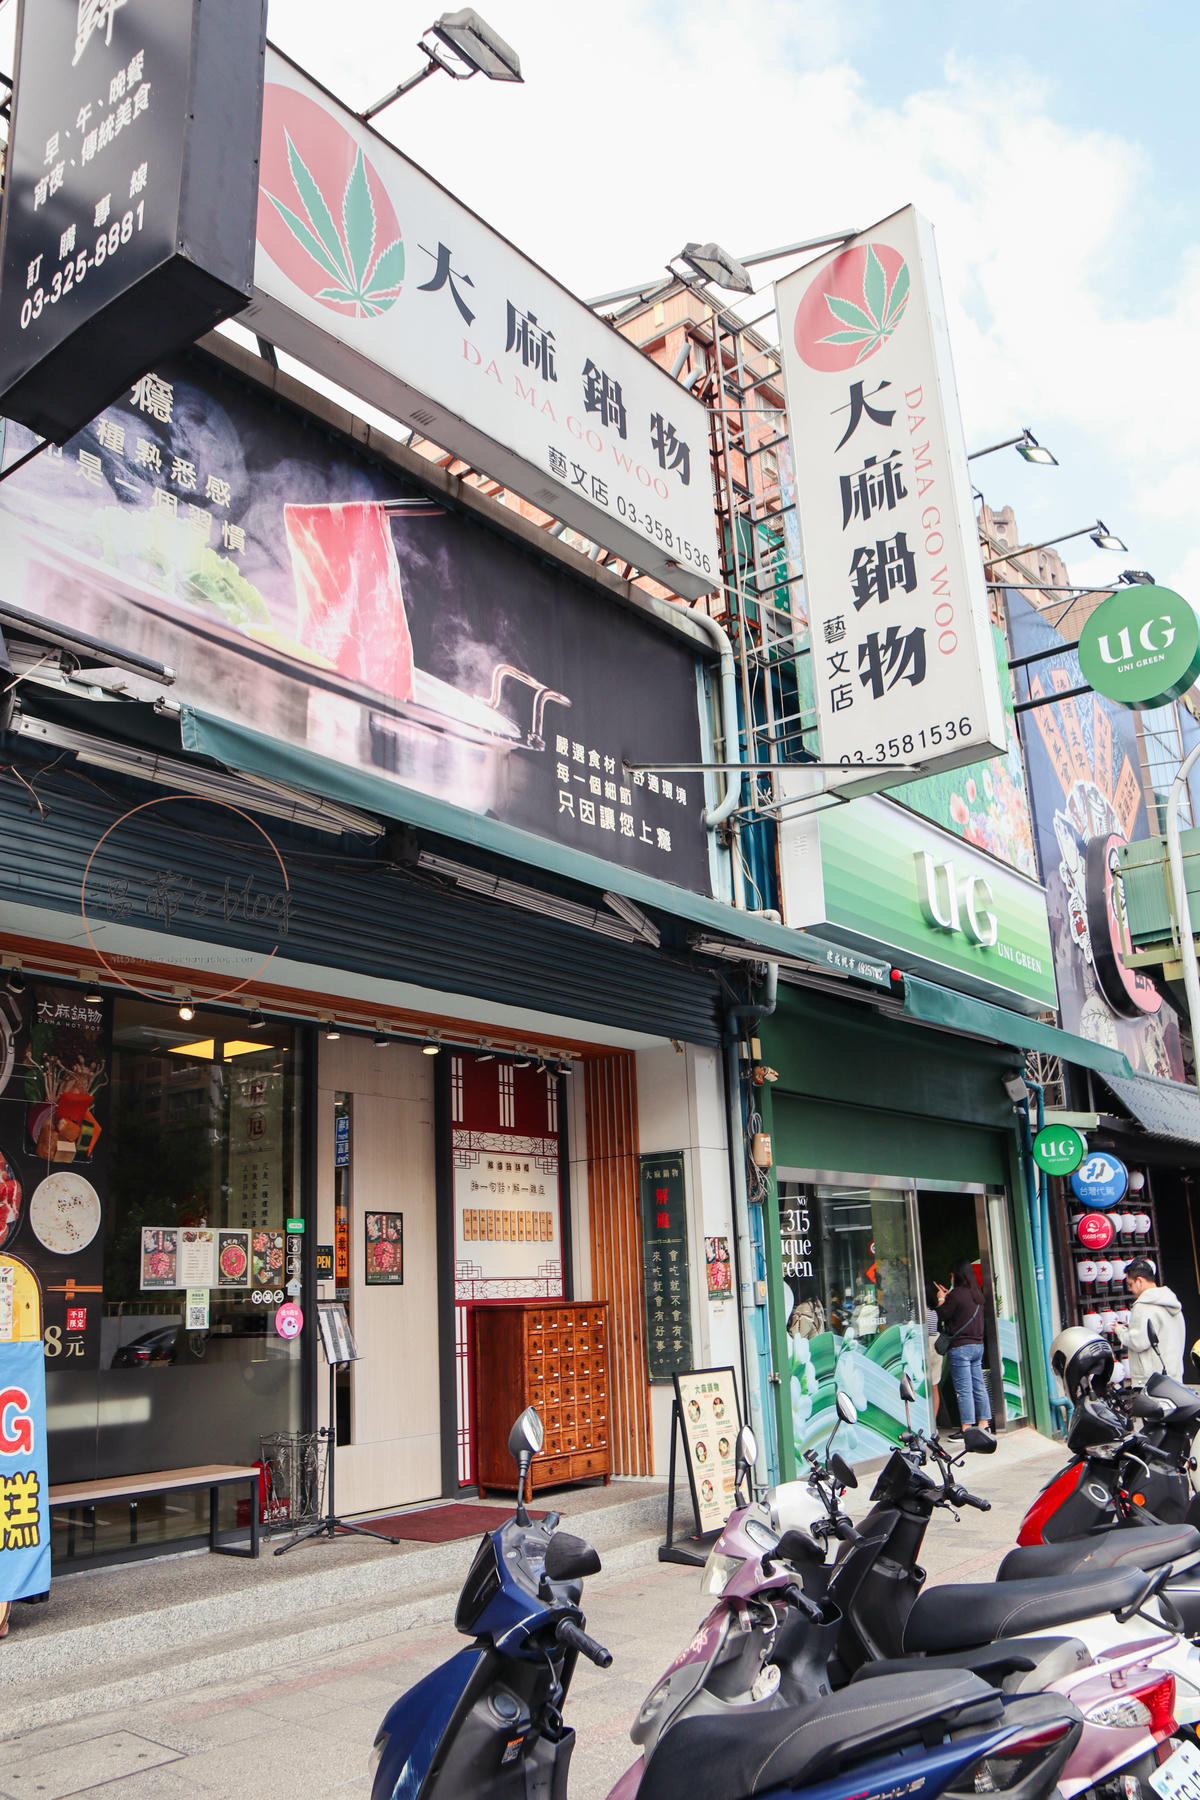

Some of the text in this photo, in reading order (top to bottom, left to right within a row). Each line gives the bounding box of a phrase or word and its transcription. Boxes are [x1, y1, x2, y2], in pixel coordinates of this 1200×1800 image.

[20, 200, 145, 330] 03-325-8881
[417, 241, 691, 486] 大麻鍋物
[461, 338, 671, 500] DA MA GO WOO
[547, 444, 609, 507] 藝文店
[616, 496, 712, 574] 03-3581536
[831, 379, 928, 699] 大麻鍋物
[904, 384, 959, 656] DA MA GO WOO
[1097, 615, 1177, 664] UG
[1117, 653, 1165, 673] UNI GREEN
[822, 615, 855, 714] 藝文店
[556, 761, 632, 806] 每一個細節
[997, 942, 1042, 975] UNI GREEN
[37, 1001, 103, 1024] 大麻鍋物
[1040, 1140, 1075, 1158] UG
[316, 1254, 331, 1270] PEN
[780, 1236, 812, 1270] ique
[781, 1259, 814, 1278] reen
